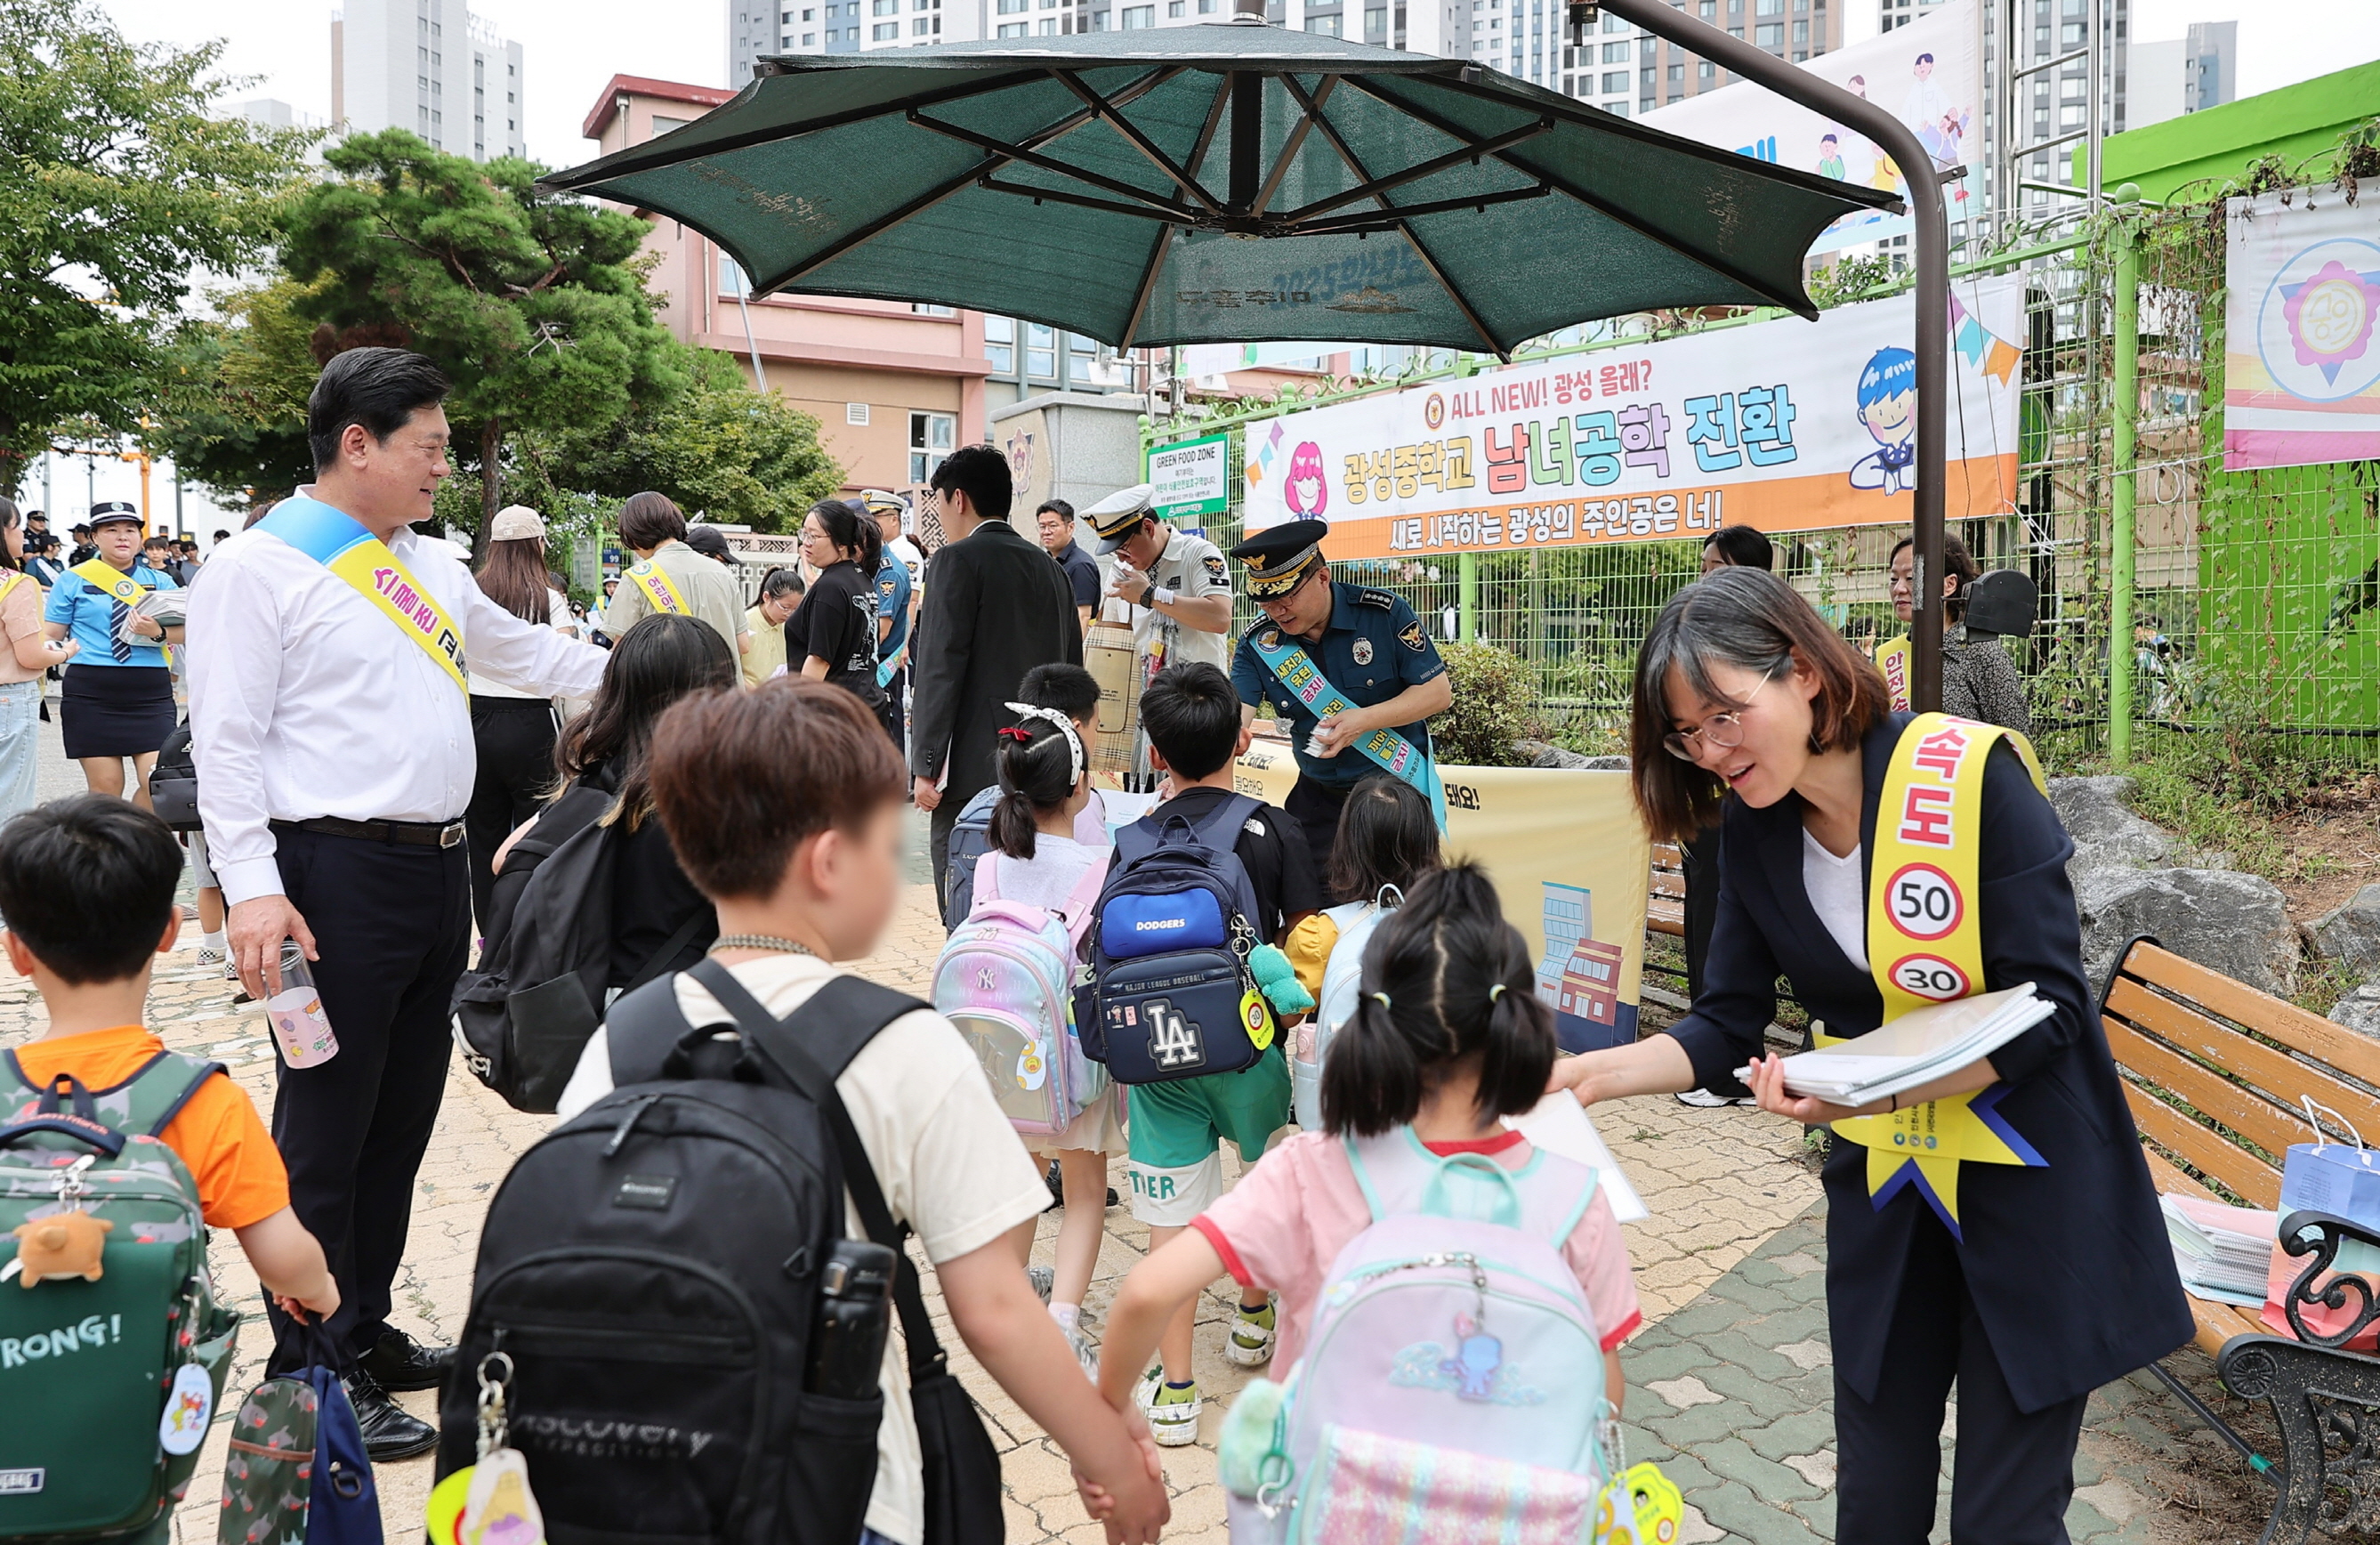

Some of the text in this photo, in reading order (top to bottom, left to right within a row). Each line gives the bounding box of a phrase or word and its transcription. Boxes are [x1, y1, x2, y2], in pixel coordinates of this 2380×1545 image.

[1450, 389, 1485, 420] ALL
[1491, 377, 1548, 414] NEW!
[1553, 369, 1592, 405] 광성
[1599, 360, 1652, 397] 올래?
[1157, 447, 1215, 468] GREEN FOOD ZONE
[1343, 435, 1475, 504] 광성중학교
[1484, 402, 1671, 495] 남녀공학
[1683, 384, 1797, 473] 전환
[1389, 490, 1722, 552] 새로 시작하는 광성의 주인공은 너!
[1275, 648, 1307, 679] 새치기
[1289, 663, 1313, 688] 유턴
[1299, 675, 1326, 703] 금지!
[1367, 728, 1389, 754] 끼어
[1378, 739, 1400, 761] 들기
[1390, 741, 1409, 772] 금지!
[1444, 783, 1480, 811] 돼요!
[1899, 883, 1950, 922] 50
[1136, 918, 1186, 931] DODGERS
[977, 967, 996, 991] NY
[1125, 974, 1206, 991] MAJOR LEAGUE BASEBALL
[1903, 967, 1957, 992] 30
[1251, 1010, 1262, 1024] 30
[1148, 1005, 1199, 1066] LA
[1129, 1170, 1176, 1200] TIER
